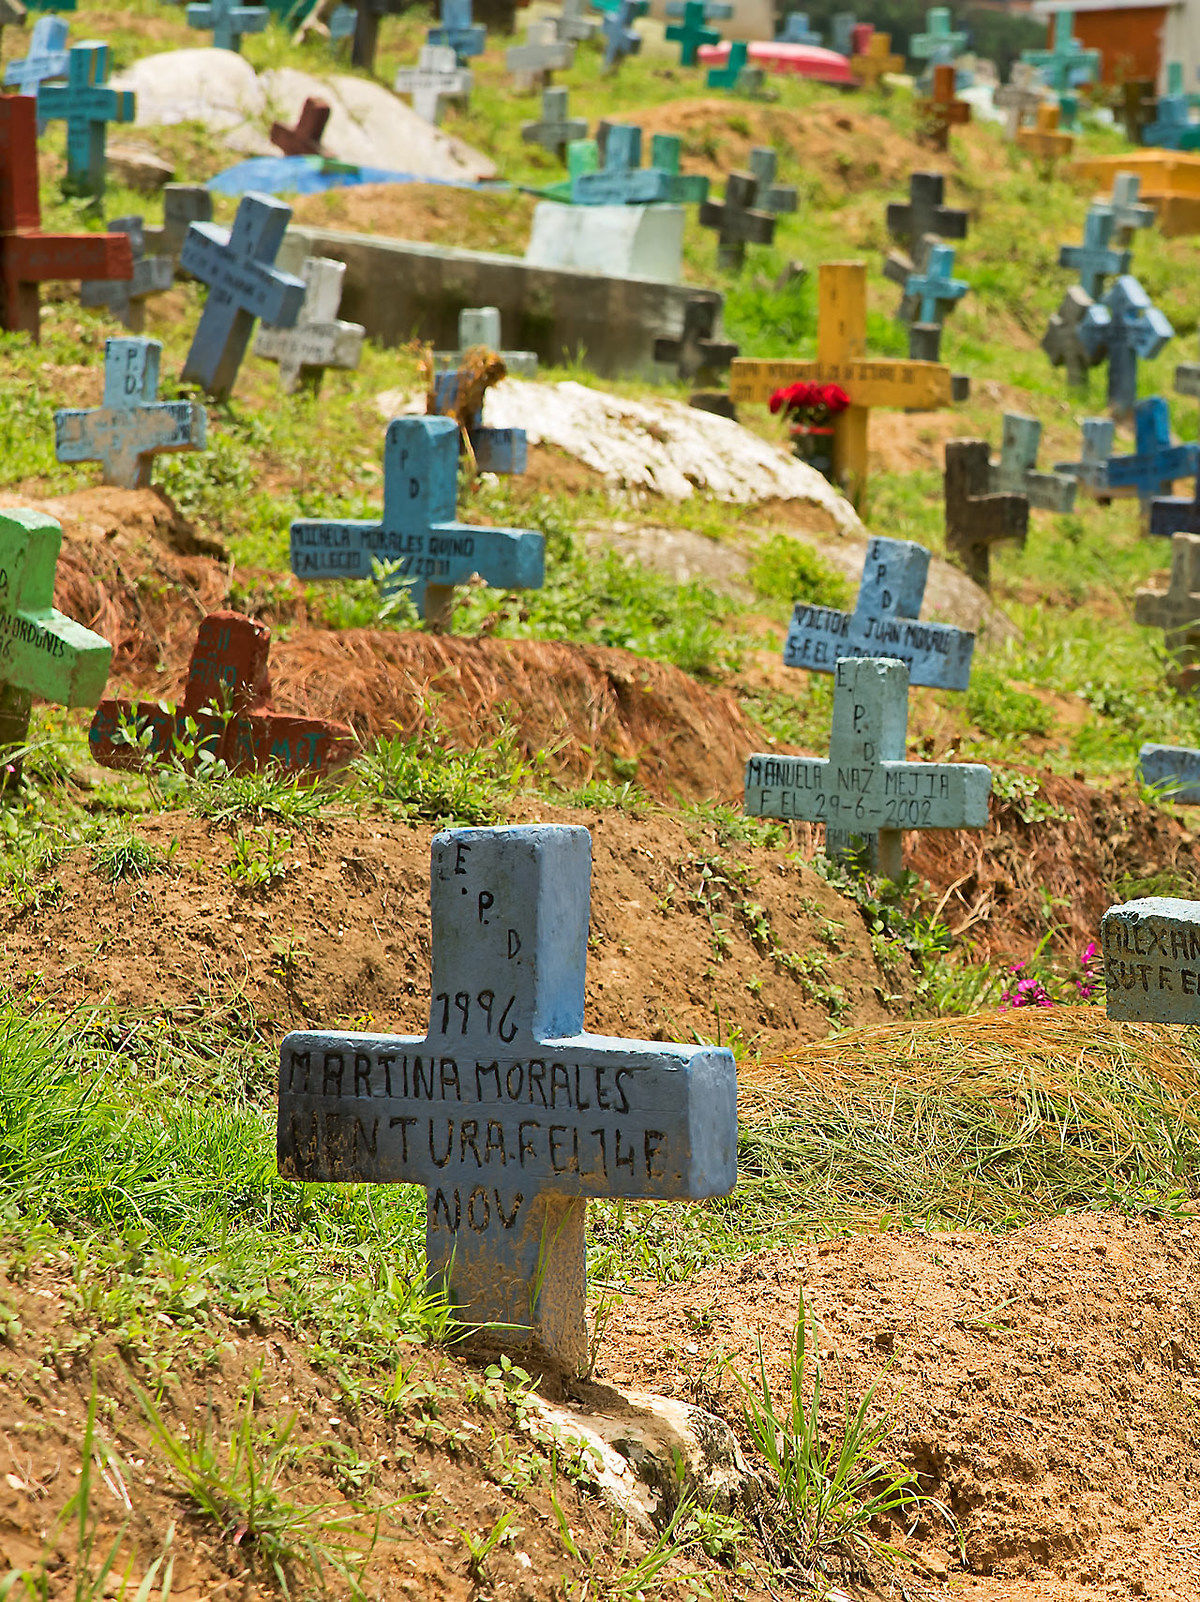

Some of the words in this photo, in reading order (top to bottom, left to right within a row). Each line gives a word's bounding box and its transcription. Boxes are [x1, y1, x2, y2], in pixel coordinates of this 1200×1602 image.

[876, 564, 887, 586] P
[882, 589, 893, 610] D
[748, 757, 823, 790] MANUELA
[885, 771, 950, 800] MEJIA
[780, 790, 803, 817] EL
[435, 990, 519, 1044] 1996
[287, 1051, 462, 1101] MARTINA
[474, 1058, 636, 1115] MORALES
[433, 1186, 526, 1235] NOV
